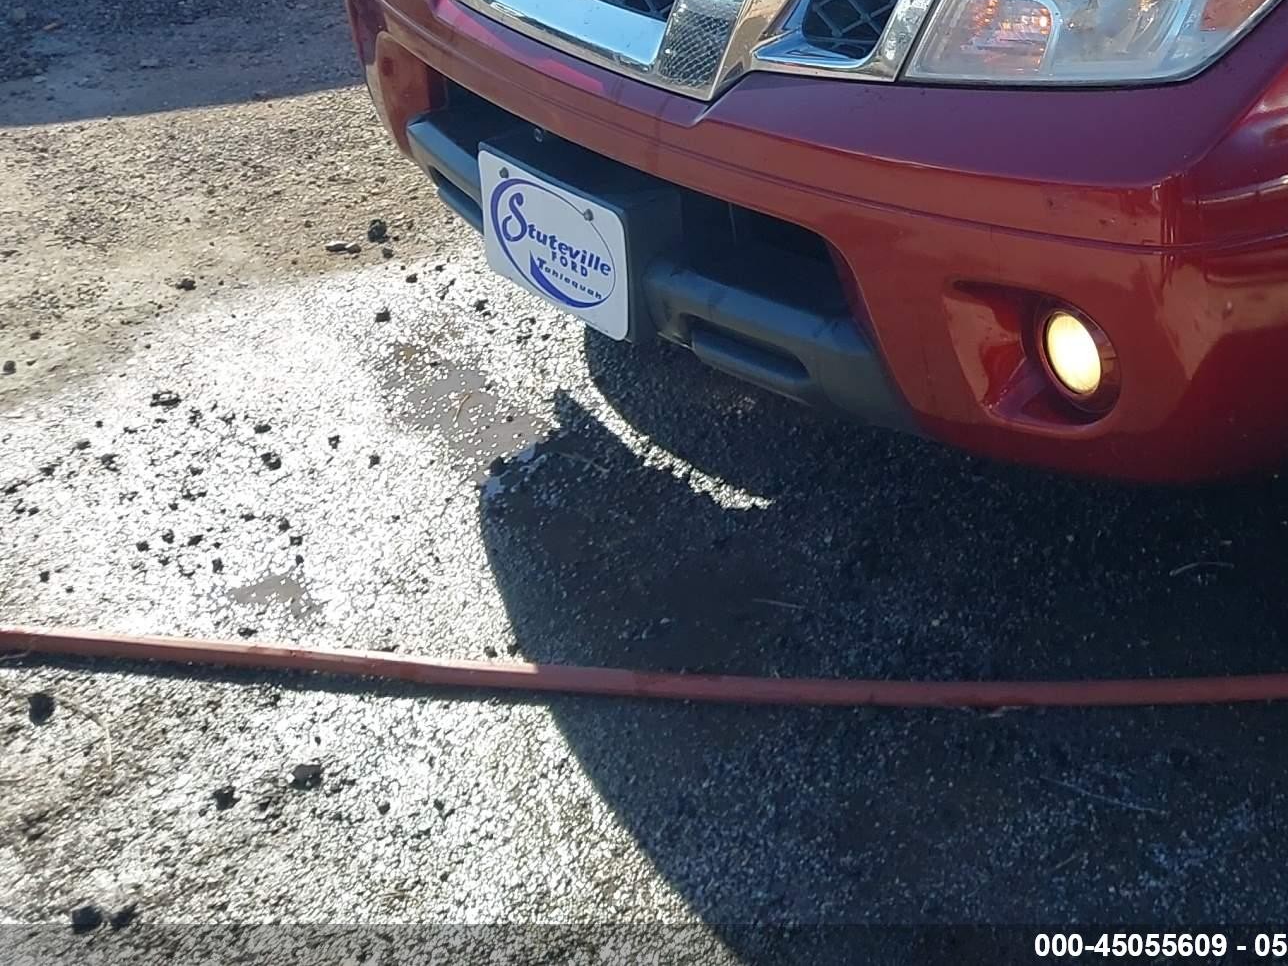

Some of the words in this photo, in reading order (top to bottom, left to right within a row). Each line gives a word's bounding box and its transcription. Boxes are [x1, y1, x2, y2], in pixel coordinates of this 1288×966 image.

[501, 191, 612, 277] Stuteville
[536, 256, 603, 300] Tahlequah
[551, 250, 589, 278] FORD
